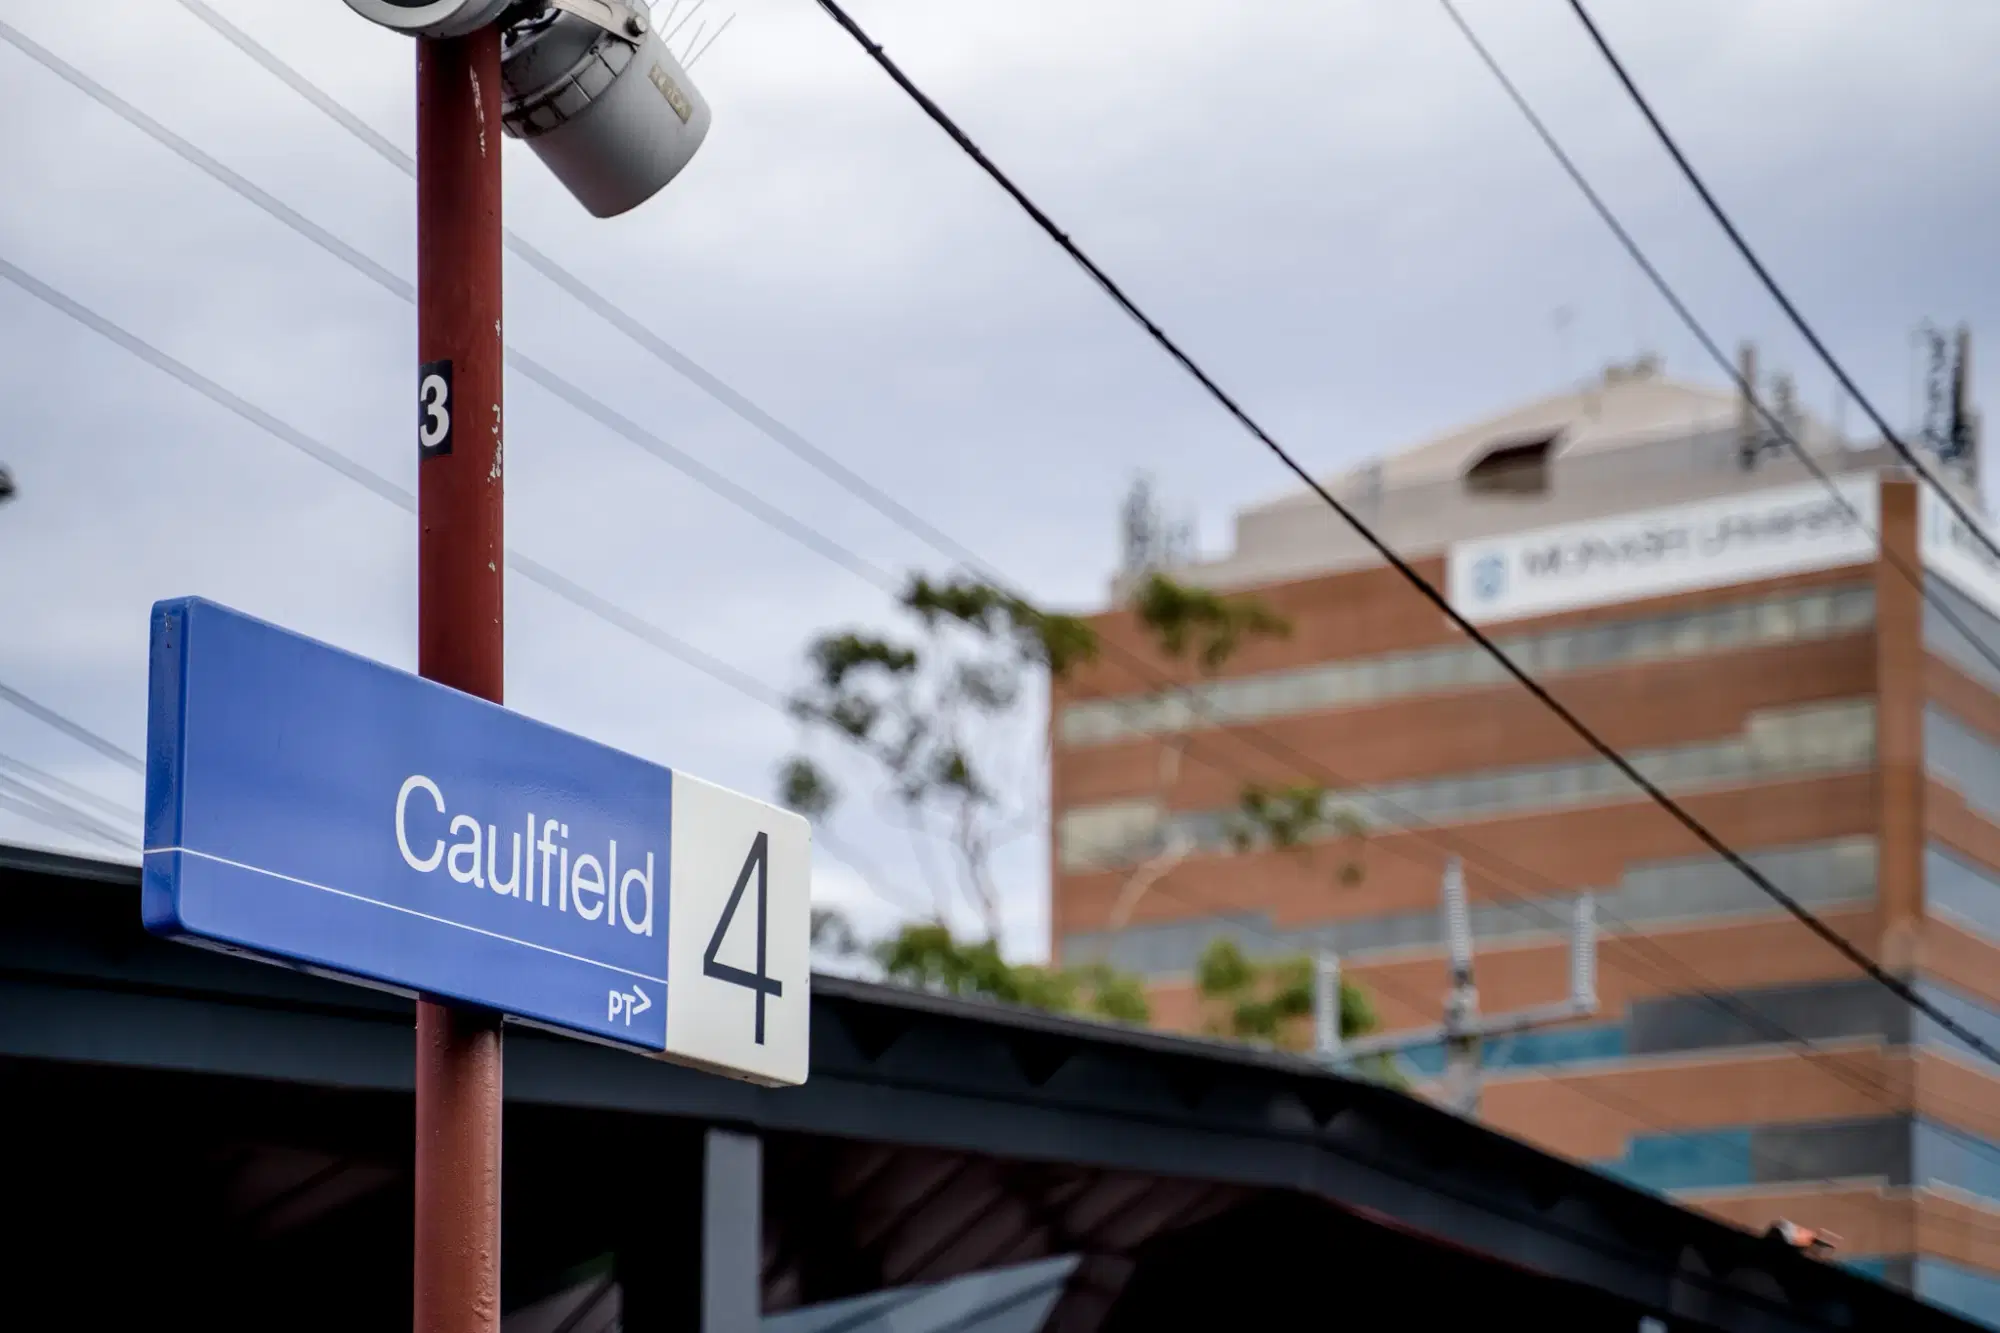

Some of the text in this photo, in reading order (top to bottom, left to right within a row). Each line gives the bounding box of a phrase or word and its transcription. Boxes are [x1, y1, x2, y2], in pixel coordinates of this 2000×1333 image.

[420, 374, 449, 447] 3
[395, 774, 654, 937] Caulfield
[703, 831, 783, 1045] 4
